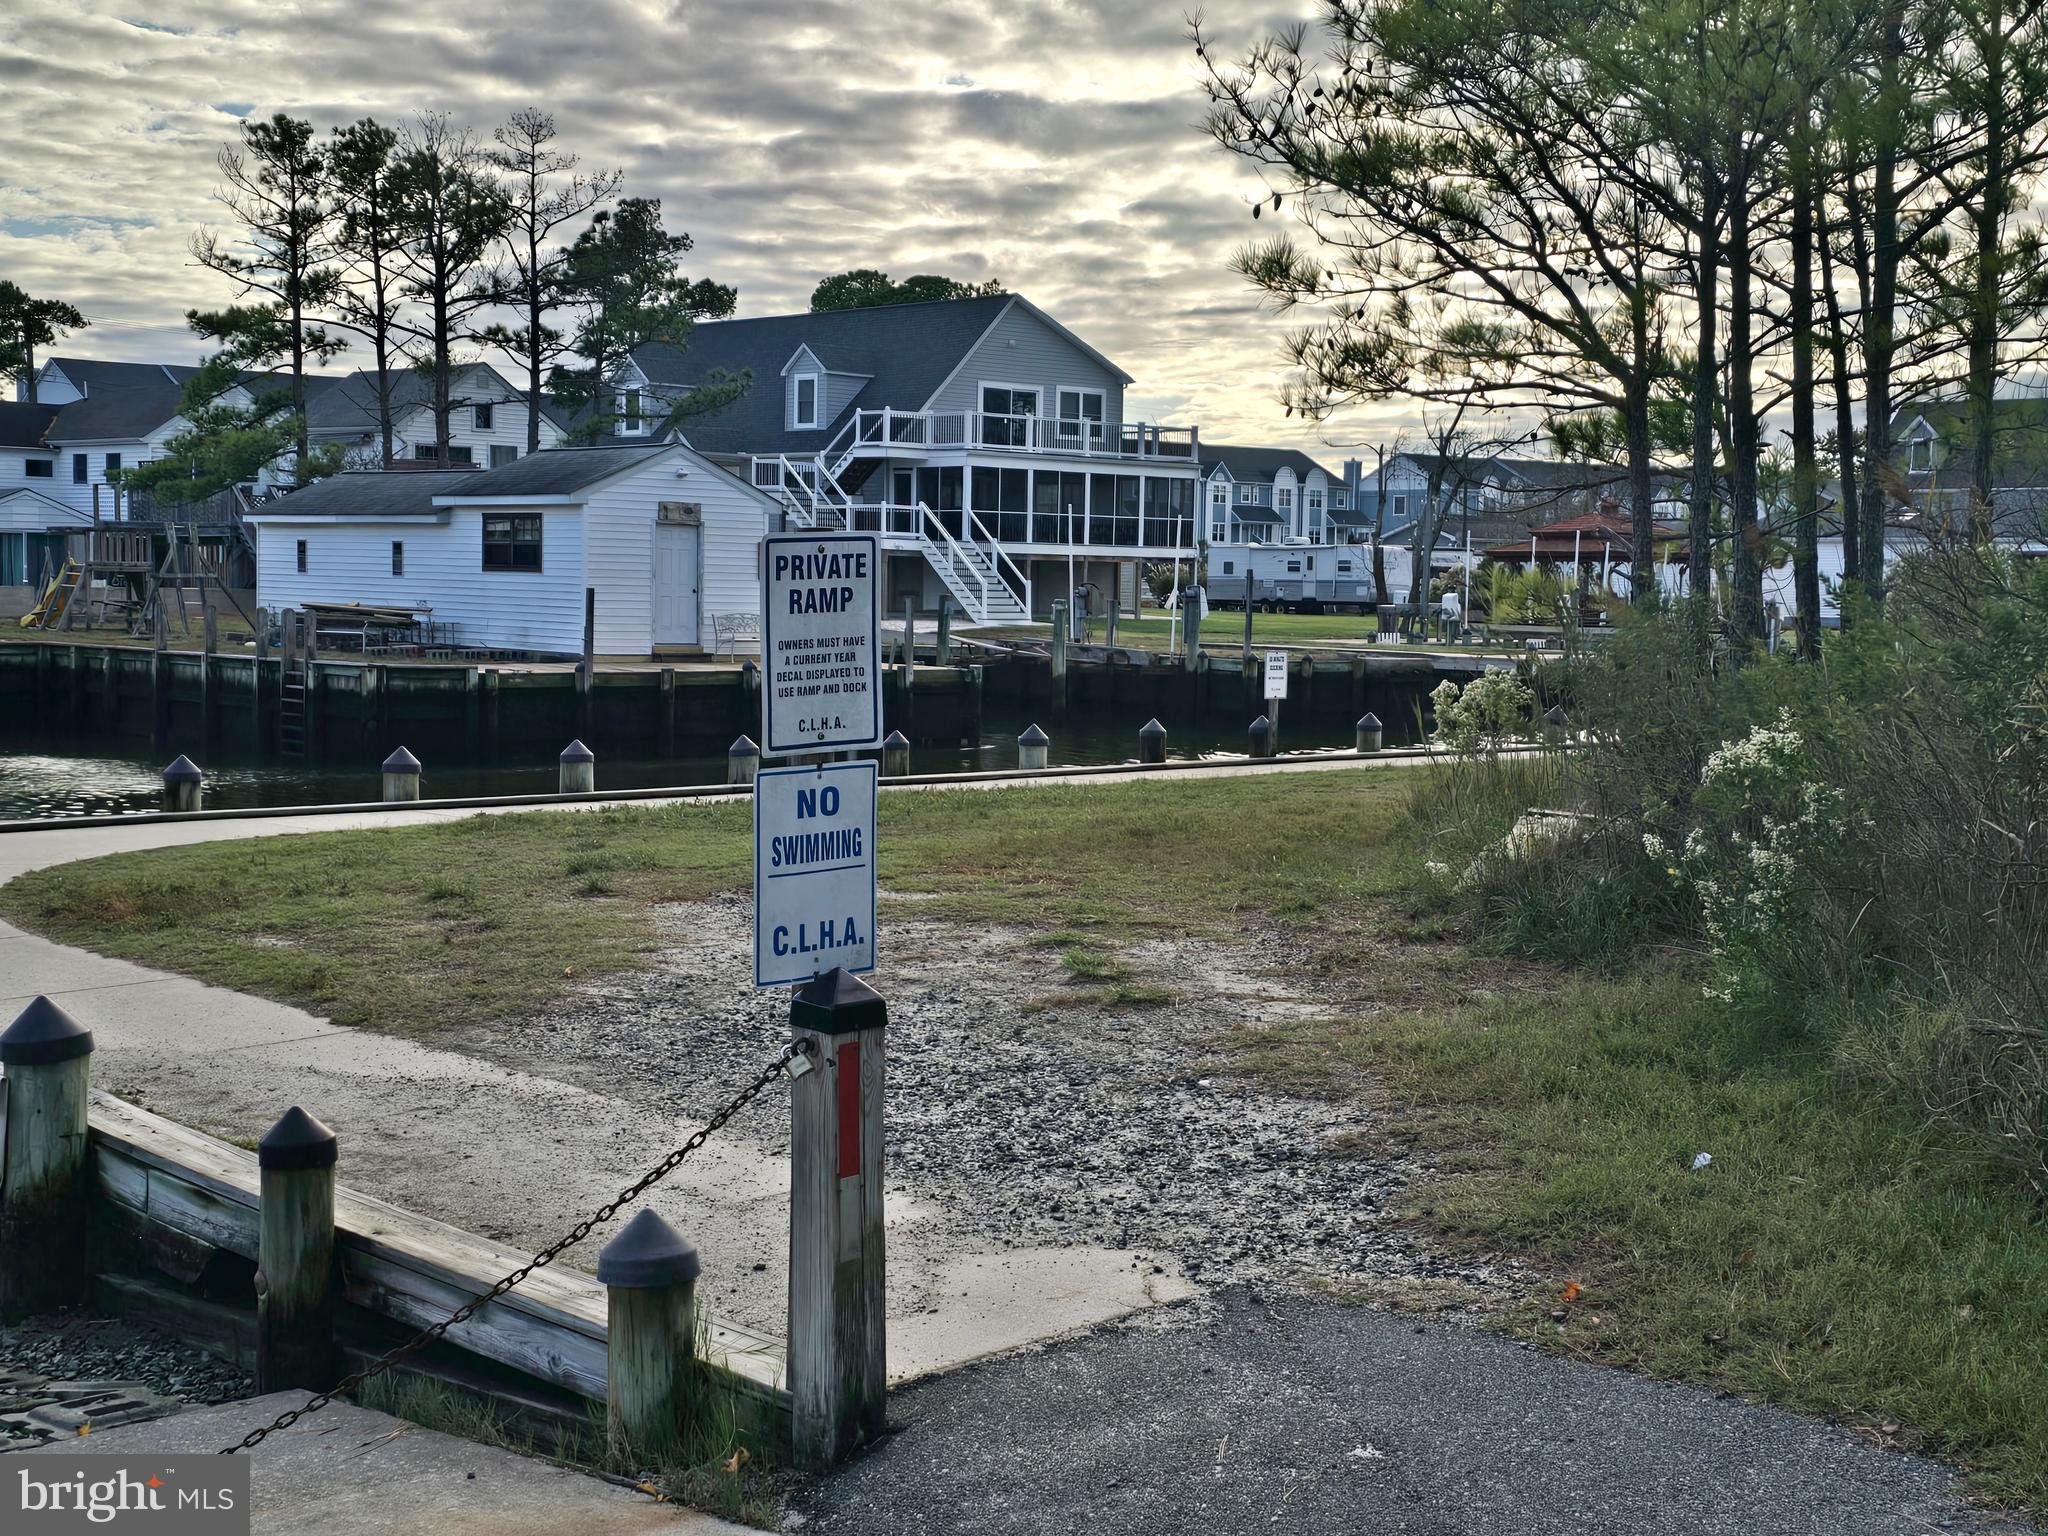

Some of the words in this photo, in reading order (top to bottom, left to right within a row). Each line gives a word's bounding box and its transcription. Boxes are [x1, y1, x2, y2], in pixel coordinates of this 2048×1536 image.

[775, 553, 867, 581] PRIVATE
[789, 587, 854, 614] RAMP
[778, 639, 814, 650] OWNERS
[816, 637, 840, 648] MUST
[843, 636, 865, 646] HAVE
[784, 656, 790, 666] A
[793, 653, 832, 665] CURRENT
[835, 652, 856, 662] YEAR
[777, 671, 803, 682] DECAL
[806, 668, 851, 680] DISPLAYED
[853, 667, 865, 676] TO
[778, 687, 794, 698] USE
[797, 685, 821, 696] RAMP
[823, 684, 840, 694] AND
[843, 682, 867, 693] DOCK
[798, 716, 846, 732] C.L.H.A.
[797, 786, 840, 819] NO
[771, 827, 862, 867] SWIMMING
[772, 917, 865, 956] C.L.H.A.
